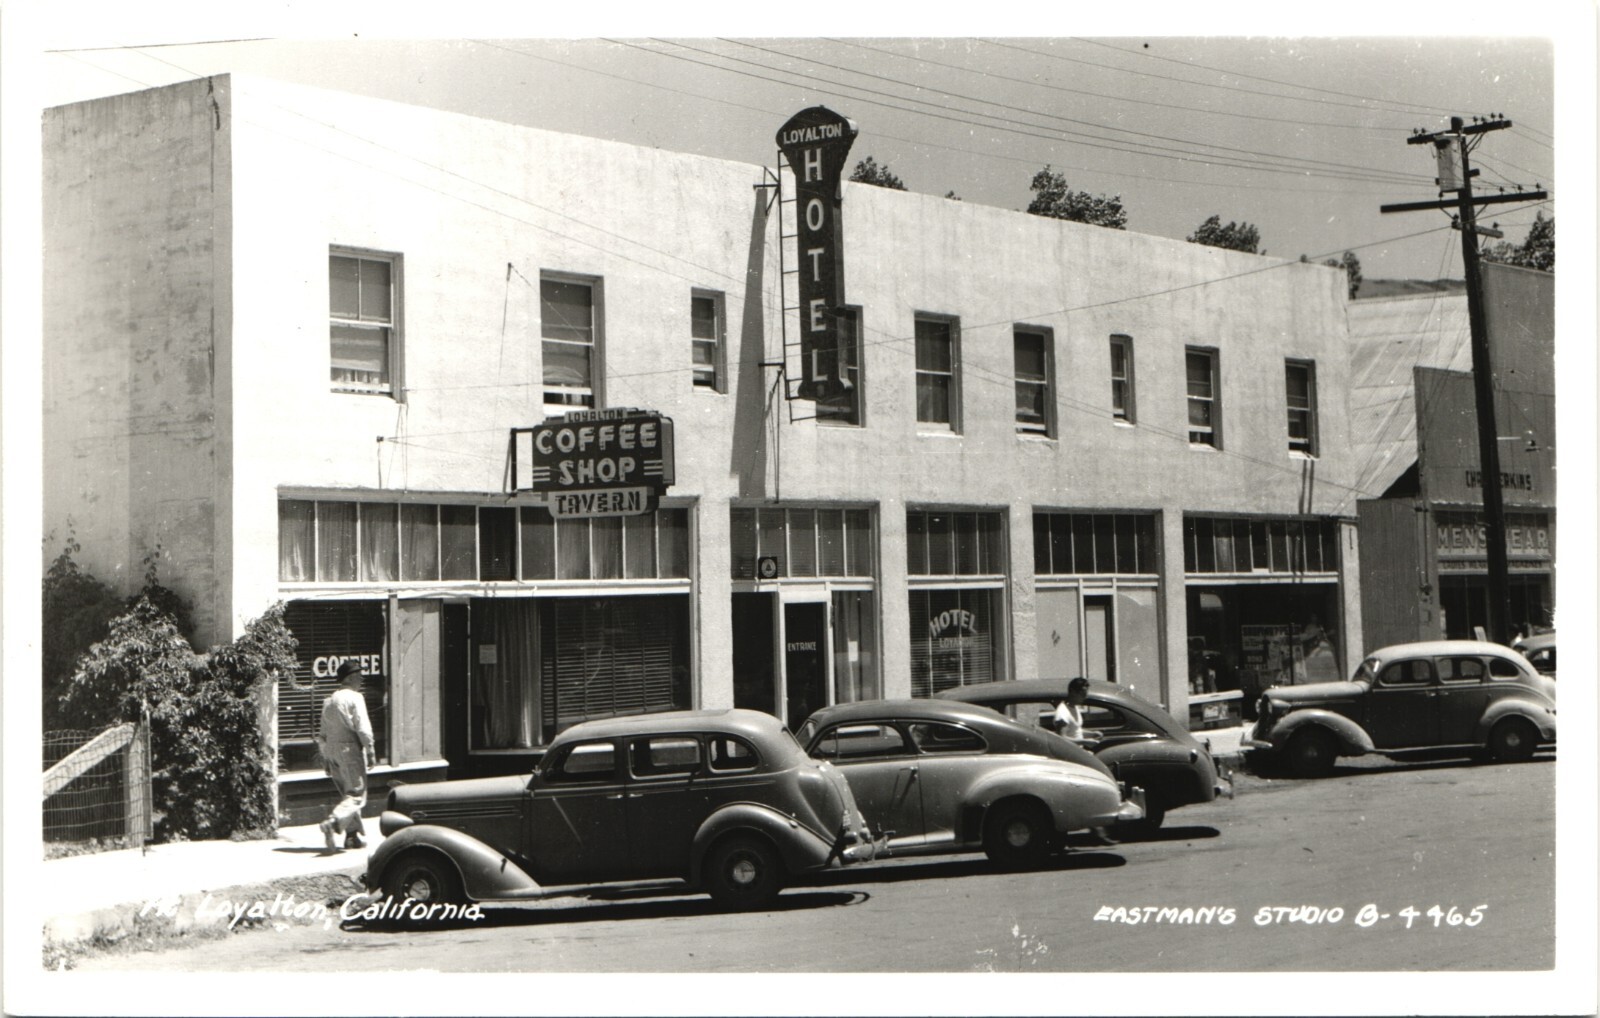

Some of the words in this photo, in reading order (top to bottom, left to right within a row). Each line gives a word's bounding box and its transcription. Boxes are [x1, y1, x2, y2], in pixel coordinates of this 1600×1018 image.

[782, 122, 842, 144] LOYALTON
[804, 148, 828, 382] HOTEL
[568, 408, 625, 422] LOYALTON
[535, 422, 657, 455] COFFEE
[558, 456, 636, 486] SHOP
[1500, 472, 1532, 491] ERKINS
[554, 490, 641, 515] TAVERN
[1505, 528, 1548, 550] EAR
[929, 608, 978, 639] HOTEL
[787, 641, 817, 652] ENTRANCE
[313, 655, 380, 677] COEE
